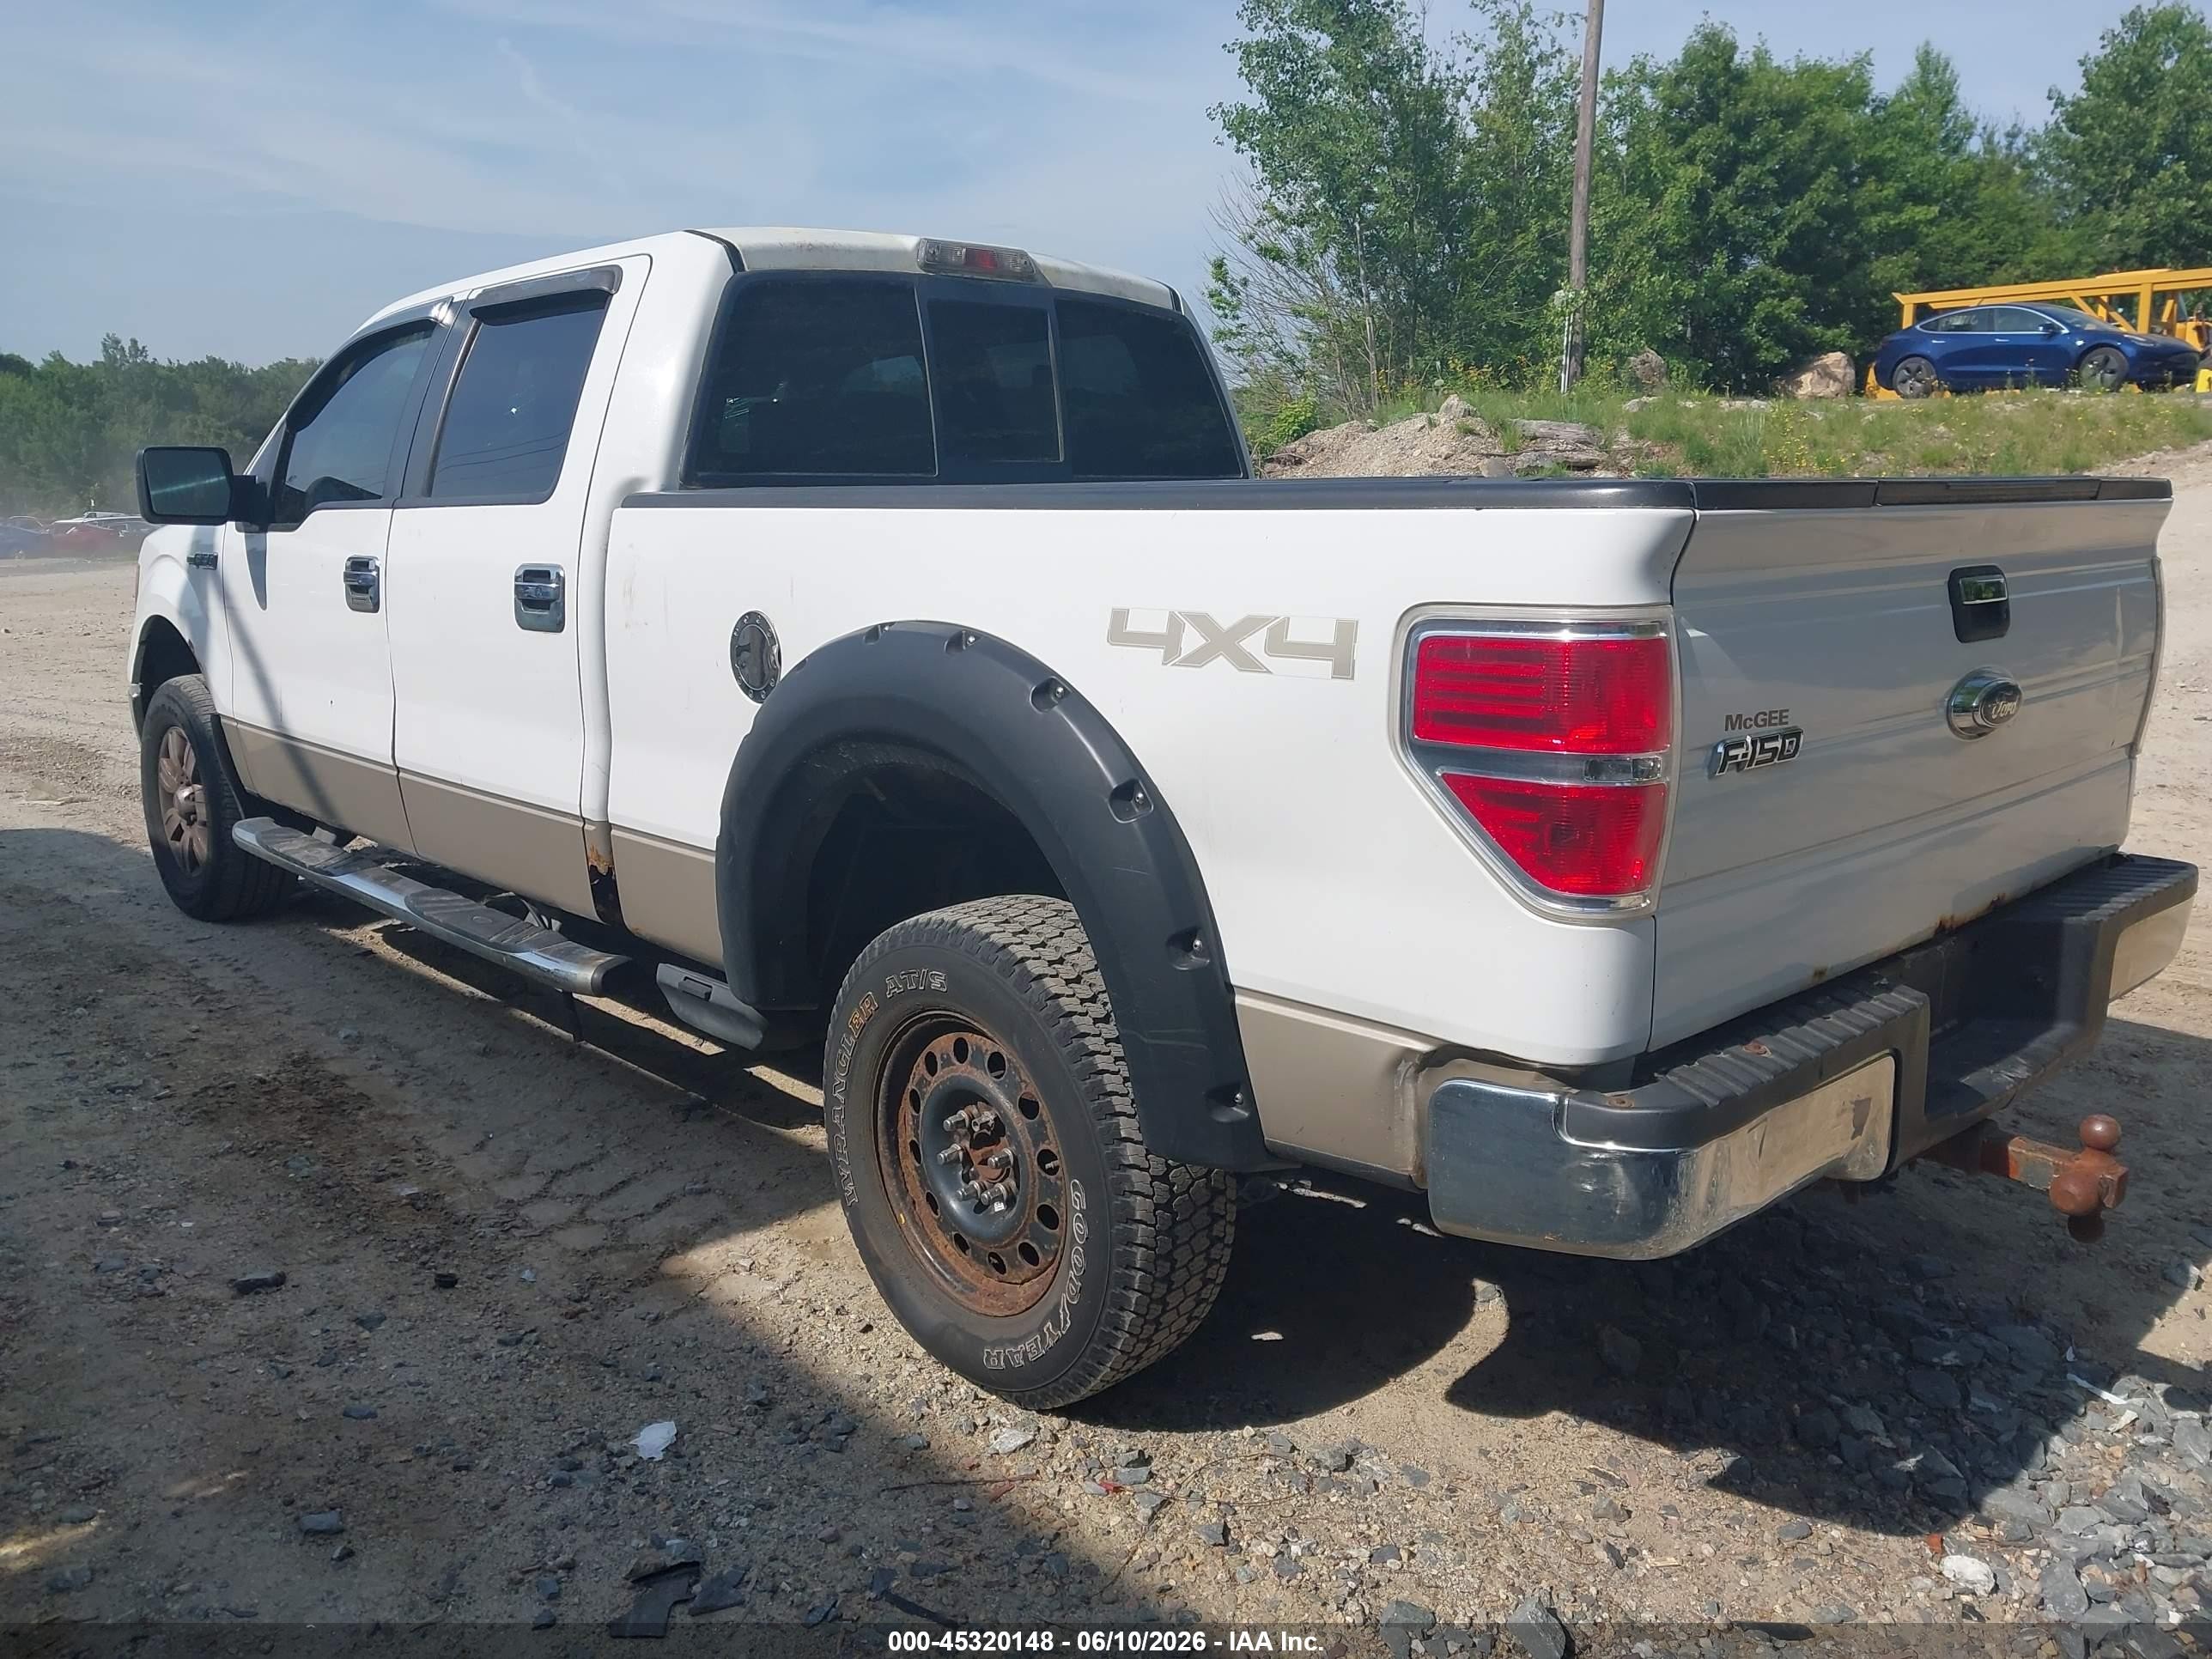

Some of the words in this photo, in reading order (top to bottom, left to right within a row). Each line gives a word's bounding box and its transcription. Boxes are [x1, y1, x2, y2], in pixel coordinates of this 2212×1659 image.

[1724, 708, 1790, 732] McGEE
[1715, 726, 1803, 776] F-150
[831, 991, 878, 1206] WRANGLER
